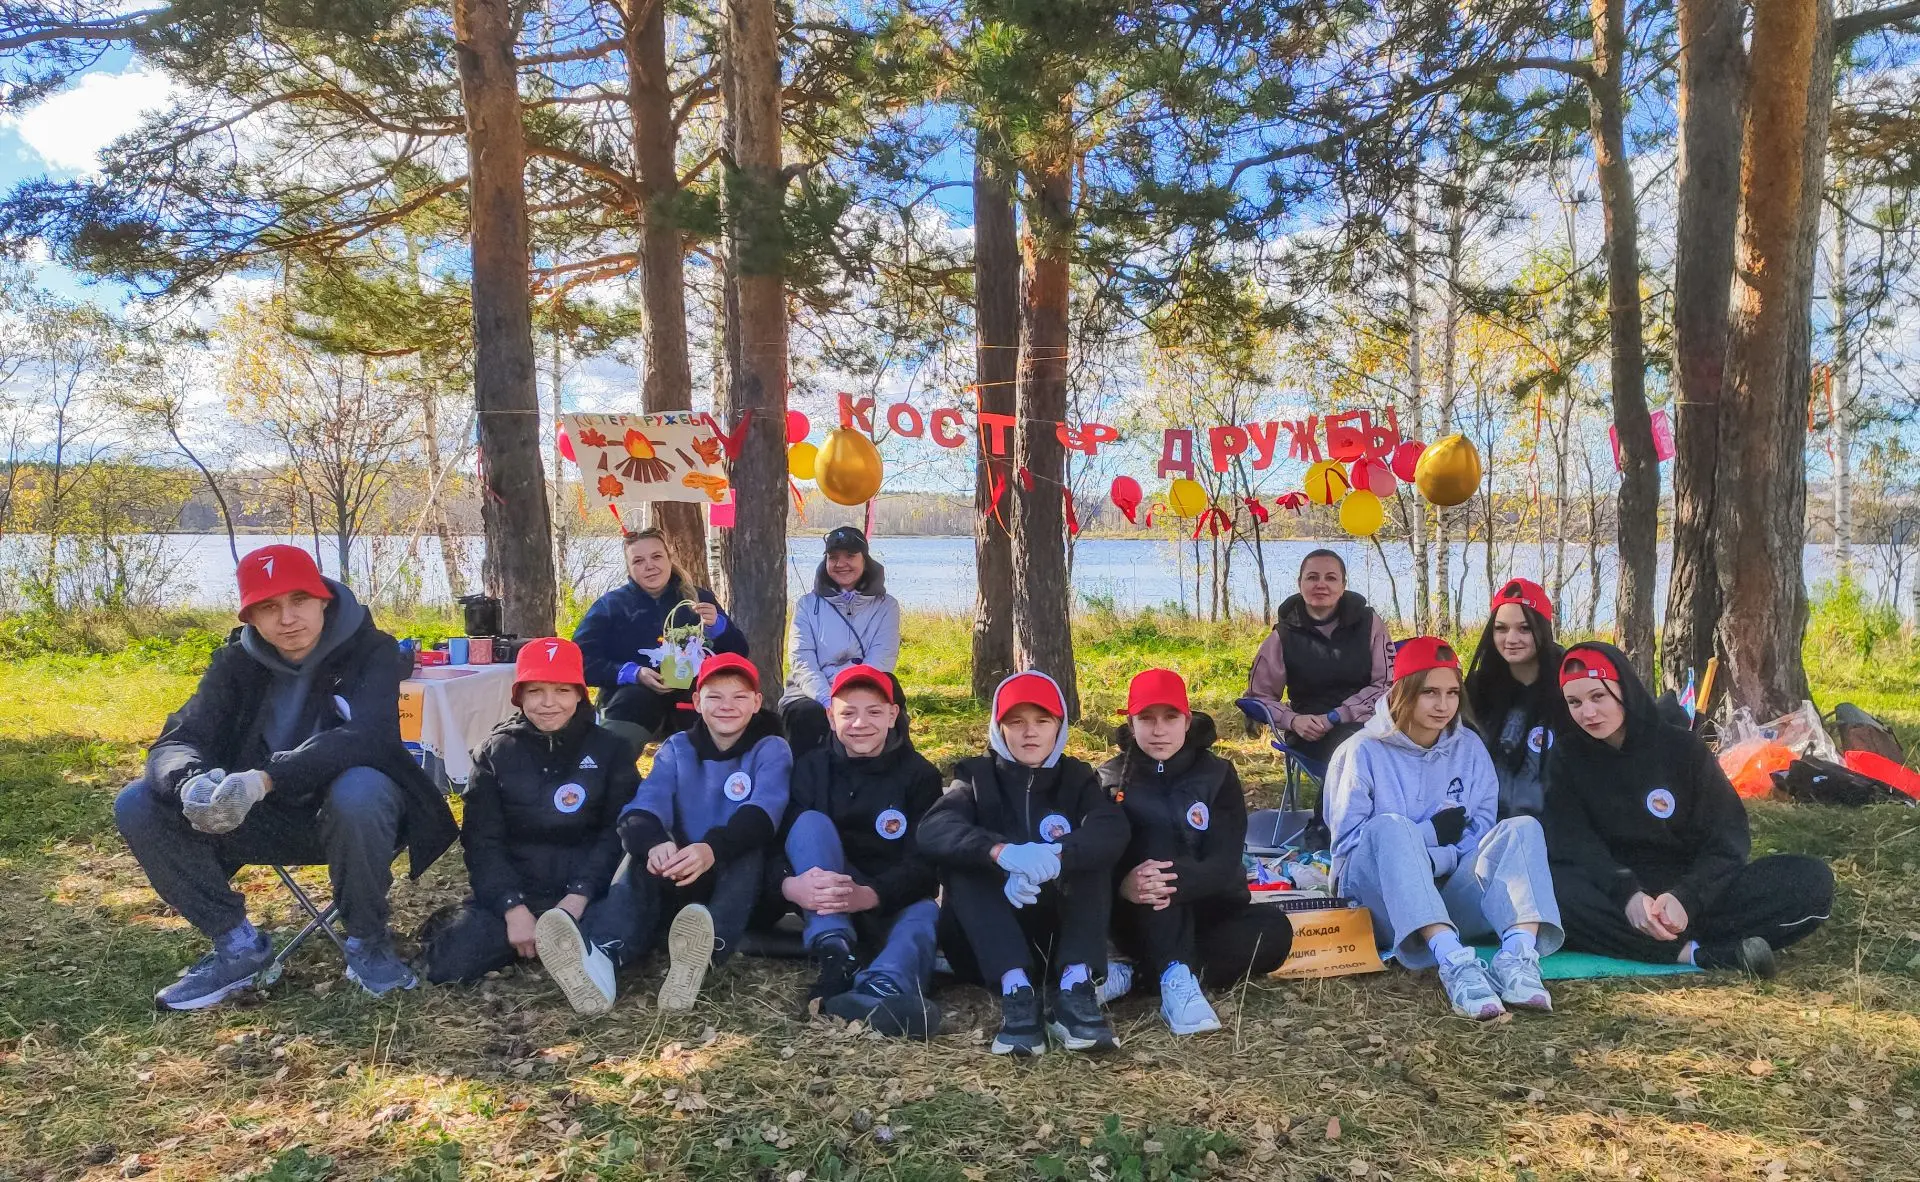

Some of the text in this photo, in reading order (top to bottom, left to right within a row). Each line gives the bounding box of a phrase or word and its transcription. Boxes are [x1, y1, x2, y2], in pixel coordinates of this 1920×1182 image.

[635, 412, 707, 427] РУЖБЫ
[1158, 404, 1401, 481] ДРУЖБЫ
[1288, 949, 1317, 959] ишка
[1336, 944, 1356, 954] это
